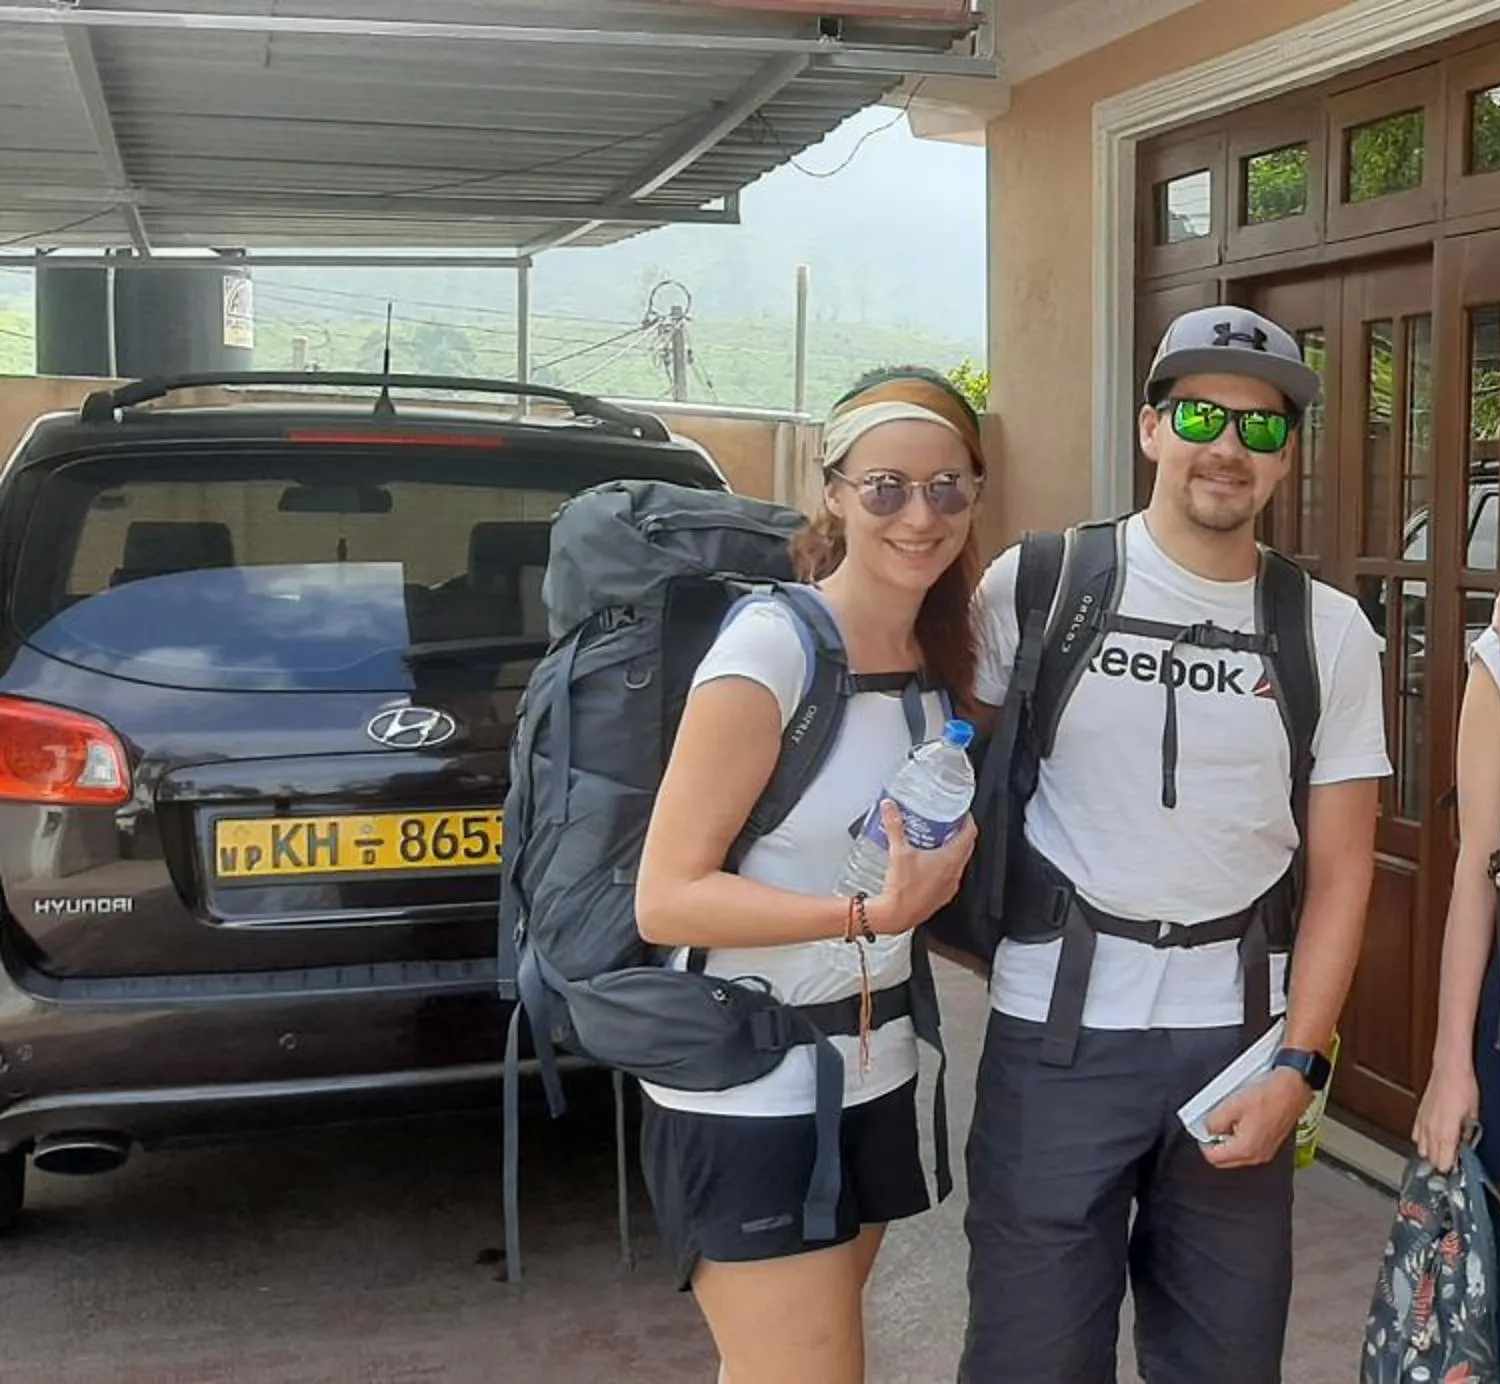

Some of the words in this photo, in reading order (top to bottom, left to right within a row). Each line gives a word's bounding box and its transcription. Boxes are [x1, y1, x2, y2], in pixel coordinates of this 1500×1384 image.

[1088, 647, 1245, 695] eebok
[271, 822, 340, 868] KH
[400, 816, 502, 862] 865
[34, 897, 134, 916] HYUNDAI
